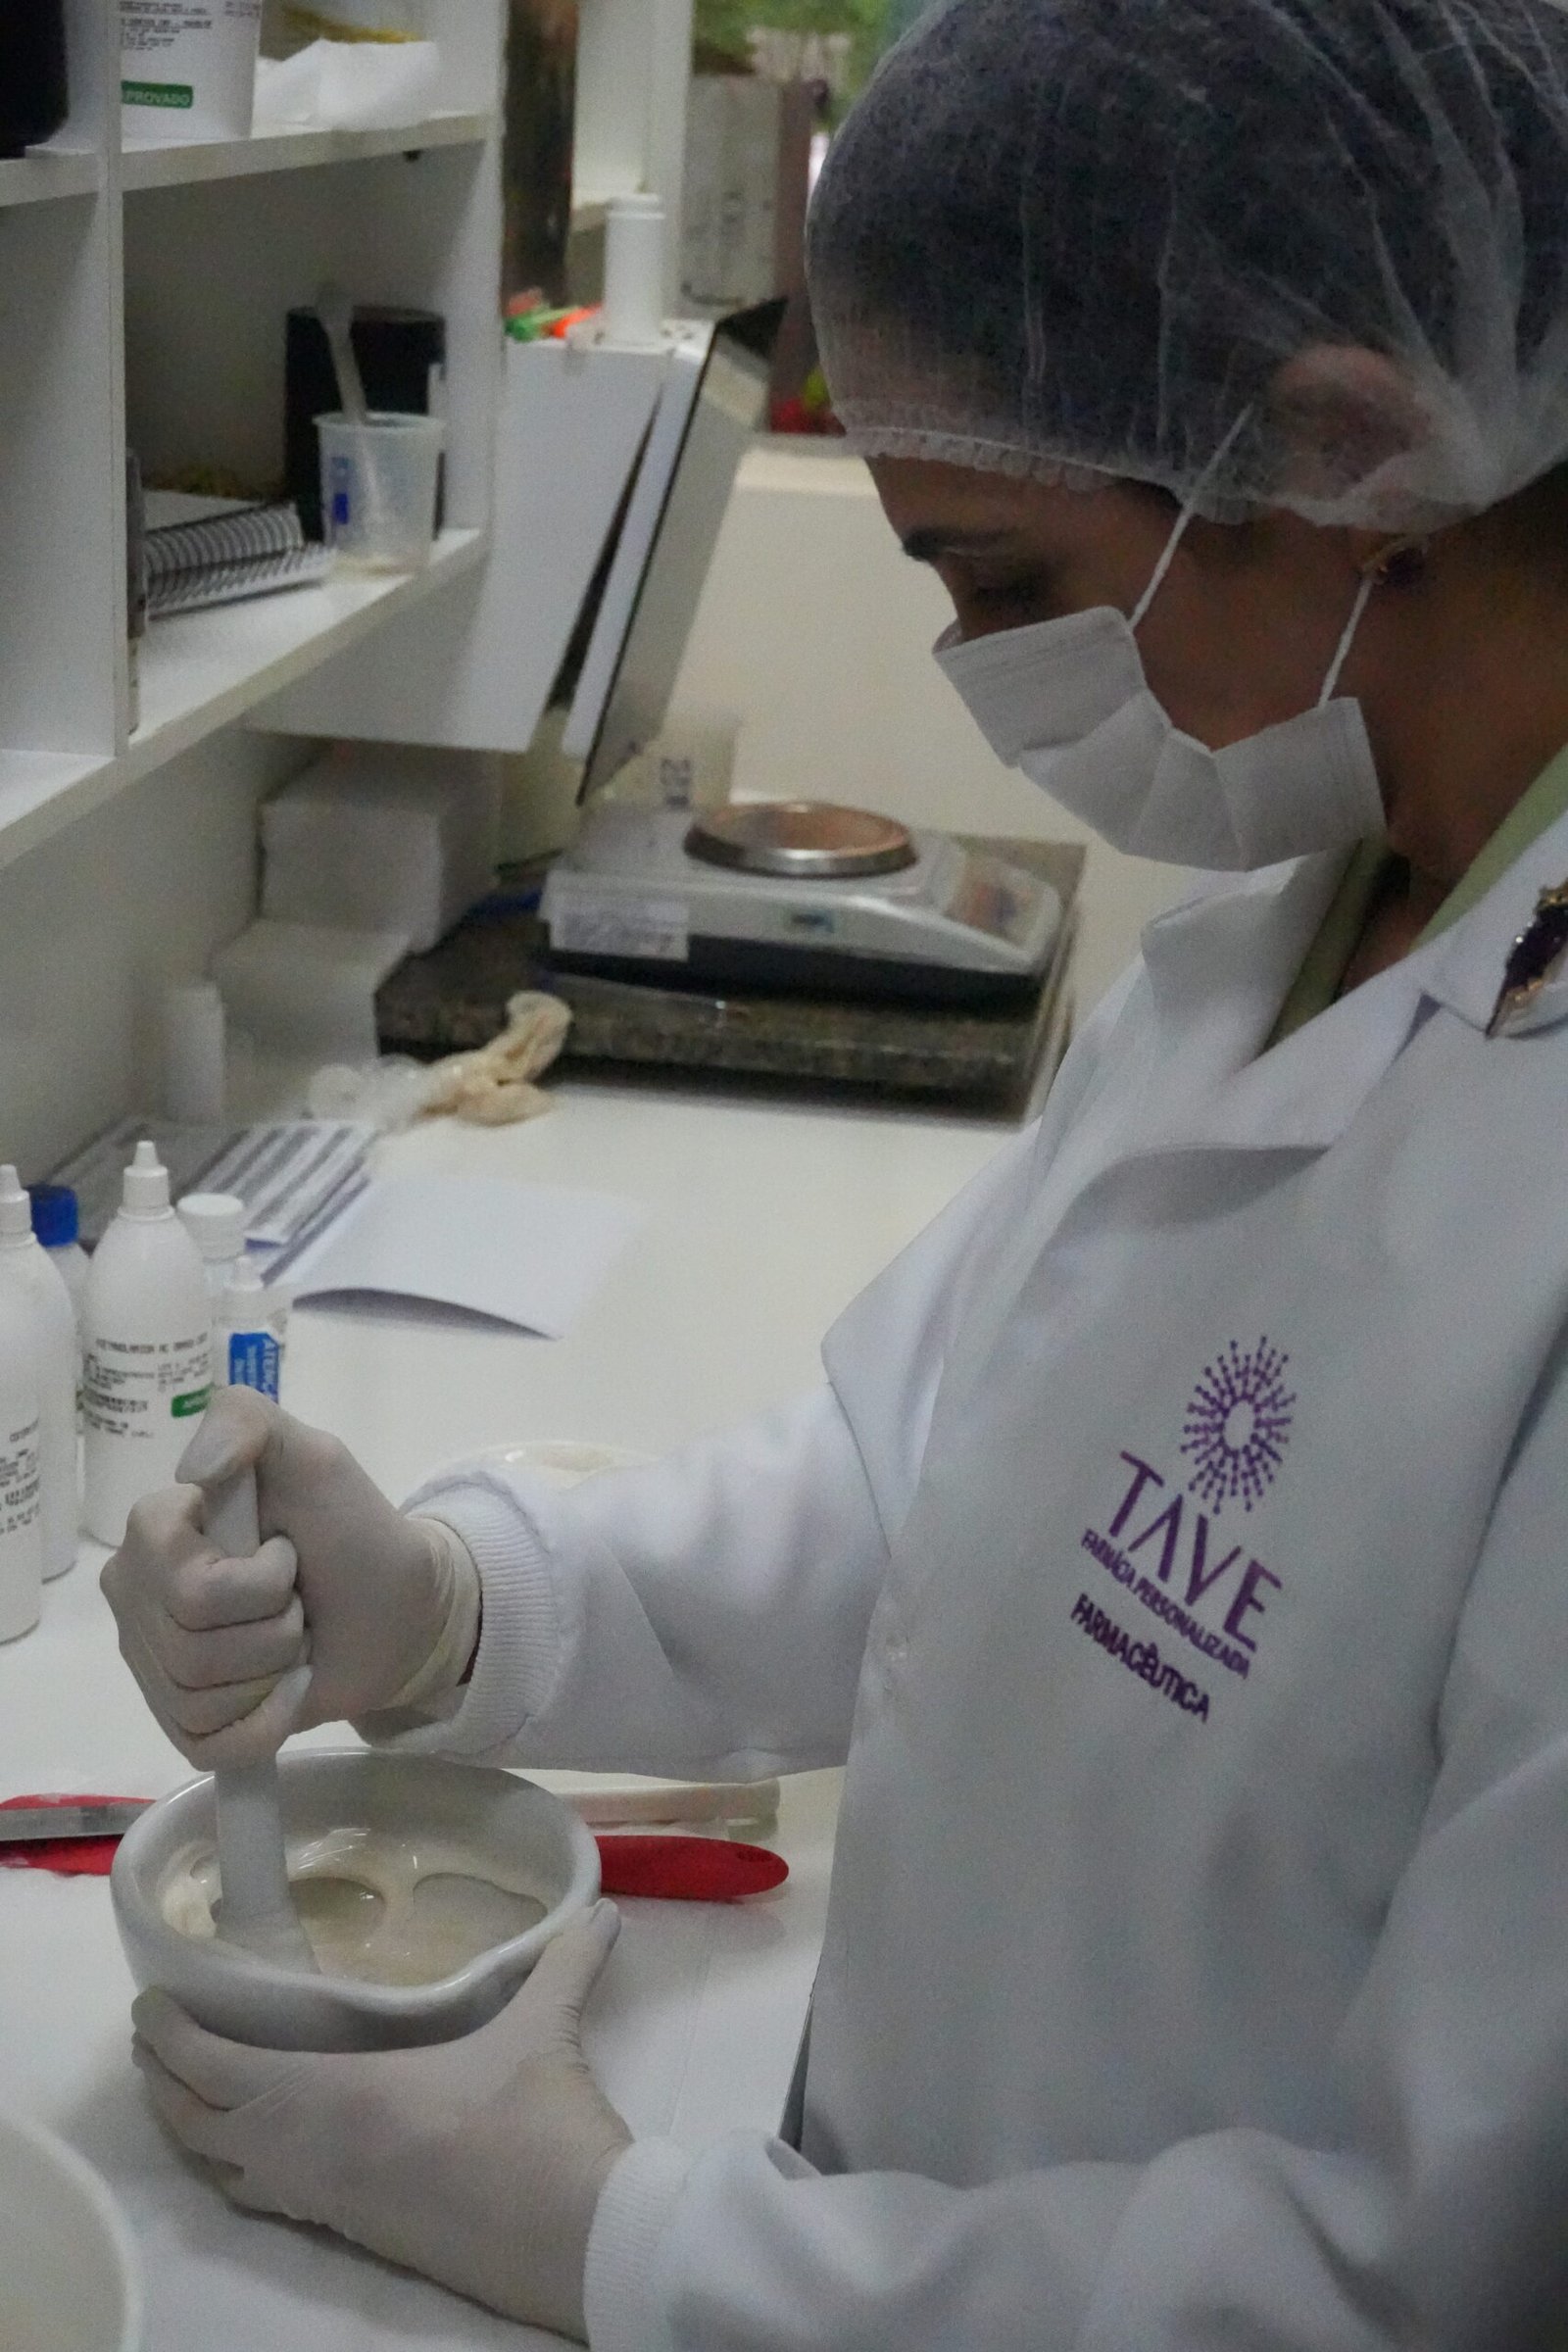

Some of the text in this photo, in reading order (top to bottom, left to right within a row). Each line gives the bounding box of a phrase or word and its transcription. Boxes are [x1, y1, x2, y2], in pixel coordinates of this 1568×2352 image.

[121, 90, 191, 108] PROVADO
[1108, 1450, 1283, 1653] TAVE
[1071, 1592, 1210, 1725] FARMACÊUTICA
[1134, 1577, 1250, 1681] PERSONALIZADA
